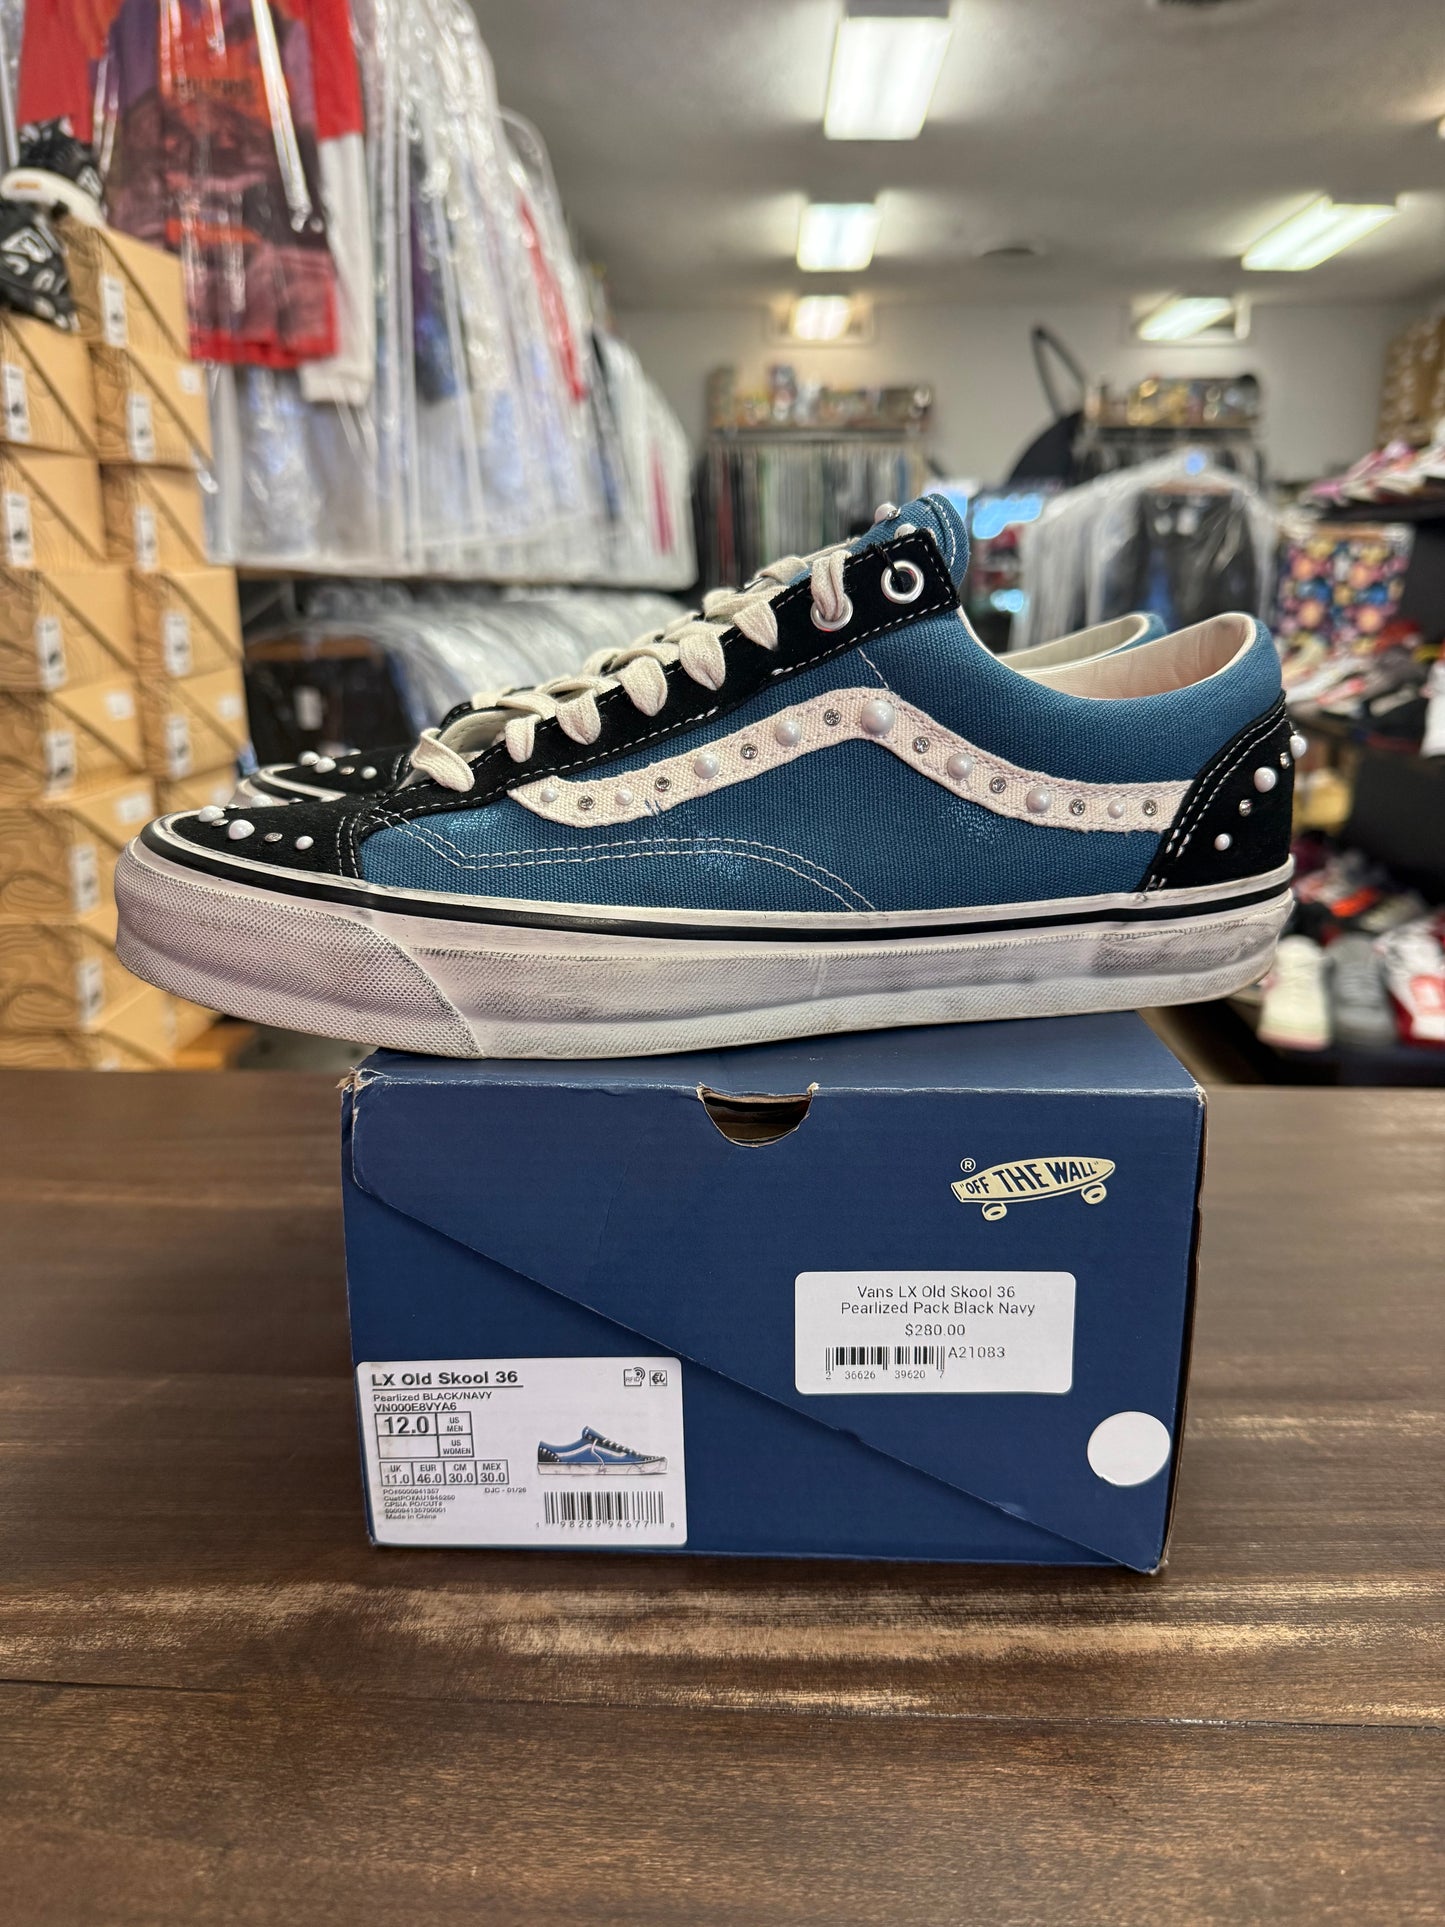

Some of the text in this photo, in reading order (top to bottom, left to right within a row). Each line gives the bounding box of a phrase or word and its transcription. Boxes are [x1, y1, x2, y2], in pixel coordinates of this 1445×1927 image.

[992, 1164, 1049, 1192] THE
[857, 1285, 1016, 1298] Vans LX Old Skool 36
[841, 1302, 1036, 1317] Pearlized Pack Black Navy
[905, 1323, 966, 1337] $280.00
[948, 1346, 1005, 1358] A21083
[372, 1371, 518, 1386] LX Old Skool 36
[826, 1370, 944, 1380] 2 36626 39620 7
[374, 1392, 492, 1402] Pearlized BLACK/NAVY
[374, 1402, 457, 1412] VN000E8VYA6
[384, 1416, 429, 1434] 12.0
[384, 1473, 505, 1484] 11.0 46.0 30.0 30.0
